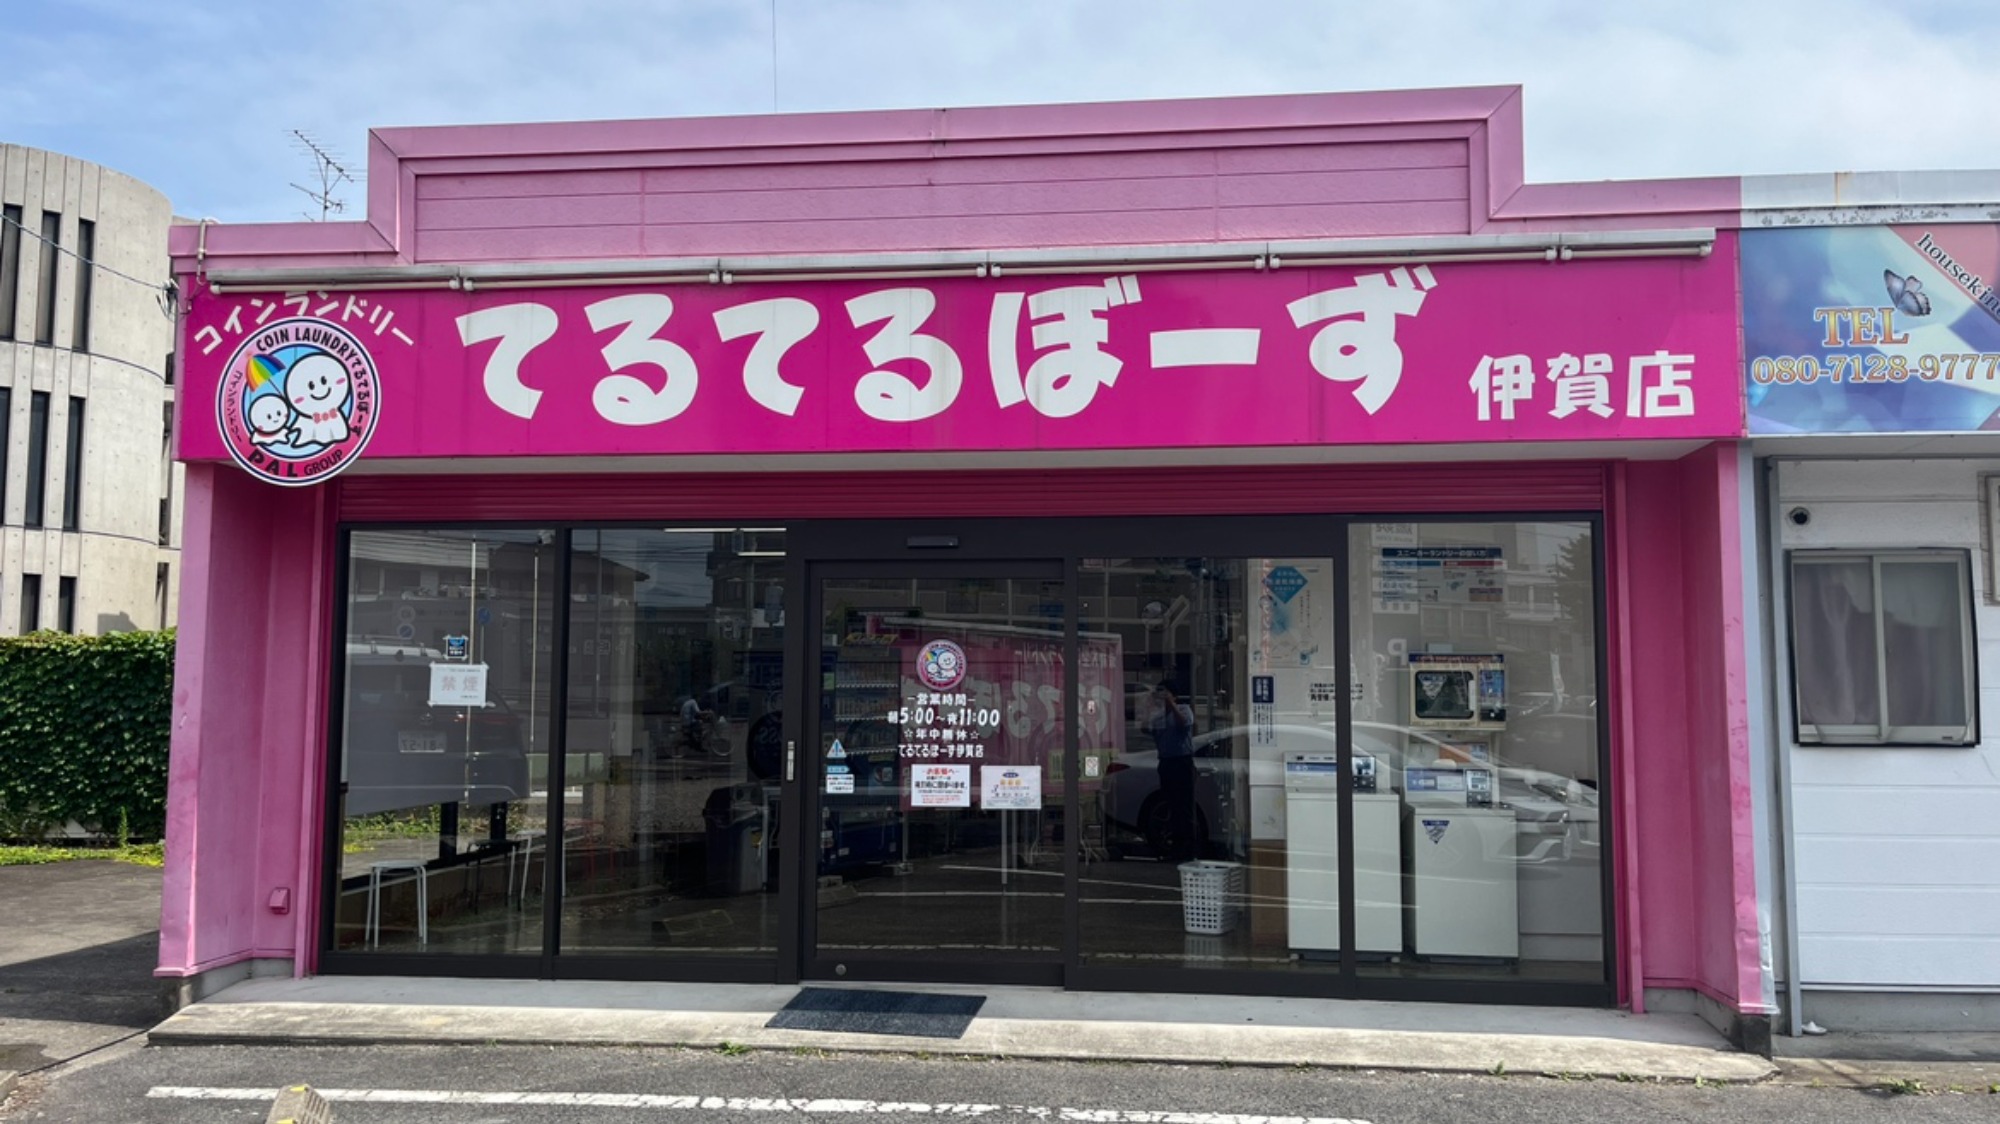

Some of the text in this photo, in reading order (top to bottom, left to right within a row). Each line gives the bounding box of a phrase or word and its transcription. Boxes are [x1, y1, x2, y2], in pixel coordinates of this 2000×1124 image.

[1917, 233, 2000, 322] housekin
[194, 290, 414, 355] コインランドリー
[1814, 307, 1910, 347] TEL
[256, 326, 357, 361] COIN LAUNDRY
[455, 264, 1438, 426] てるてるぼーず
[1468, 350, 1696, 421] 伊賀店
[1752, 353, 2000, 385] 080-7128-9777
[247, 448, 345, 478] PAL GROUP
[440, 674, 479, 693] 禁煙
